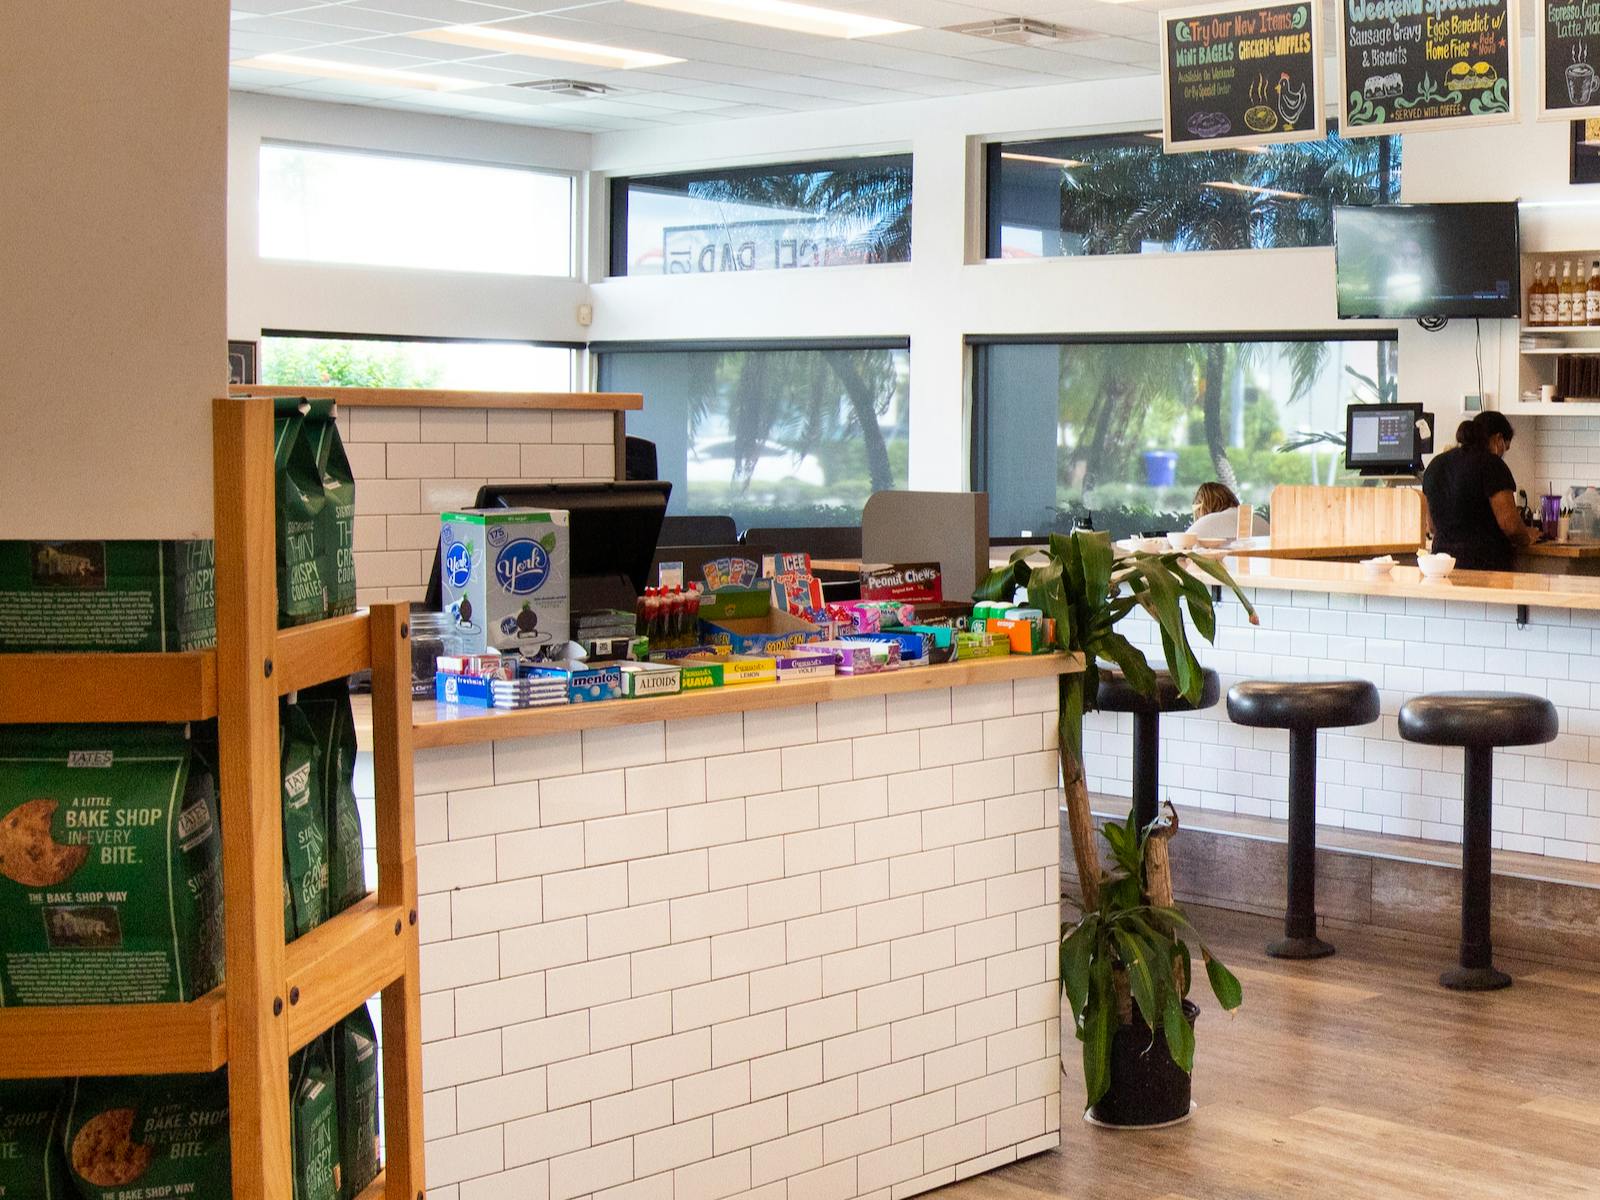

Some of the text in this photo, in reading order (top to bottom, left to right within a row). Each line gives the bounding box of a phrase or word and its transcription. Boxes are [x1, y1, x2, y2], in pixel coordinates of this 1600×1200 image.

[1350, 0, 1423, 24] Weekend
[1190, 21, 1210, 47] Try
[1212, 17, 1232, 39] Our
[1235, 16, 1256, 36] New
[1350, 23, 1422, 47] Sausage Gravy
[1427, 16, 1449, 42] Eggs
[1452, 13, 1490, 35] Benedict
[1200, 42, 1234, 64] BAGELS
[1362, 48, 1407, 67] & Biscuits
[1426, 39, 1470, 60] Home Fries
[1395, 105, 1462, 121] SERVED WITH COFFEE
[291, 561, 319, 585] CRISPY
[446, 552, 468, 586] York
[497, 547, 544, 594] York
[783, 554, 806, 572] ICEE
[869, 568, 936, 589] Peanut Chews
[292, 579, 322, 602] COOKIES
[457, 676, 486, 686] freshmint
[573, 671, 619, 687] mentos
[640, 676, 676, 689] ALTOIDS
[739, 671, 760, 679] LEMON
[73, 797, 112, 808] A LITTLE
[66, 808, 162, 828] BAKE SHOP
[87, 829, 131, 845] EVERY
[101, 845, 143, 865] BITE.
[29, 891, 128, 903] THE BAKE SHOP WAY
[171, 1141, 208, 1160] BITE.
[174, 1182, 195, 1194] WAY
